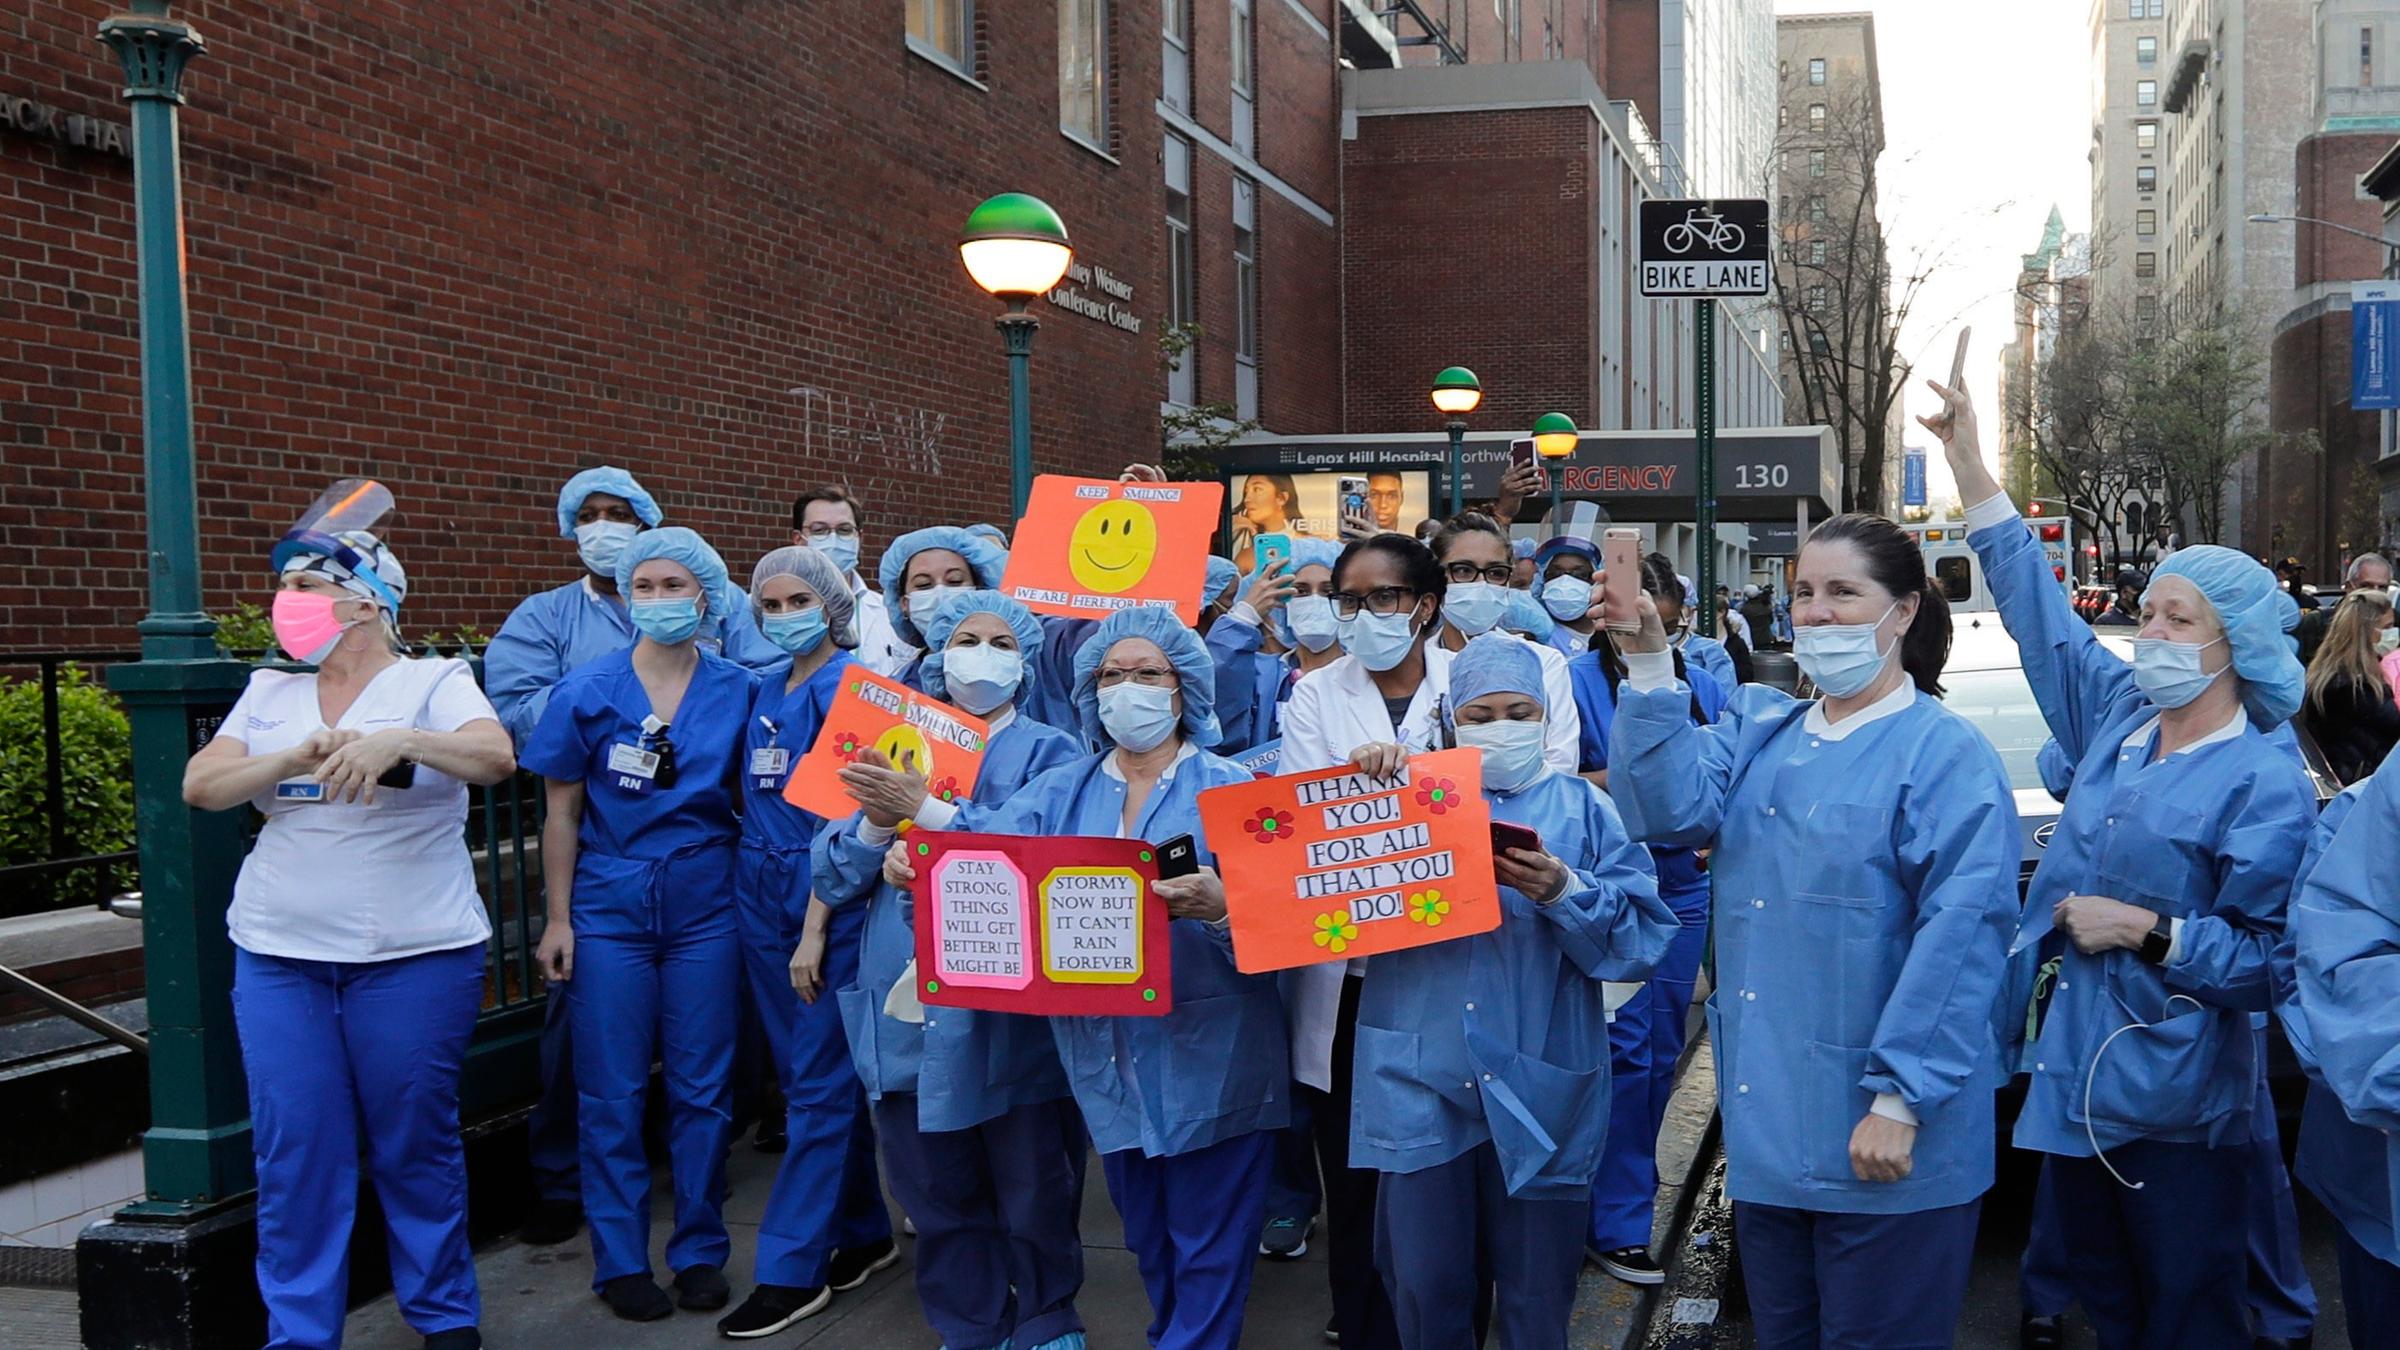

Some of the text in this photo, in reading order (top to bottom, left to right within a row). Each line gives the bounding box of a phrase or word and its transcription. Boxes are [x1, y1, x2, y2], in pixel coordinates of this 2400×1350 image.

[1094, 265, 1133, 302] Weisner
[1646, 265, 1762, 289] BIKE LANE
[1048, 287, 1141, 334] Conference Center
[1297, 451, 1344, 465] Lenox
[1349, 450, 1375, 464] Hill
[1379, 450, 1444, 463] Hospital
[1537, 465, 1677, 491] RGENCY
[1735, 464, 1789, 489] 130
[1077, 486, 1108, 498] KEEP
[1016, 588, 1038, 599] WE
[1040, 591, 1067, 603] ARE
[1073, 596, 1107, 607] HERE
[1110, 598, 1135, 609] FOR
[861, 683, 980, 752] KEEP SMILING!!
[618, 776, 642, 790] RN
[759, 778, 775, 788] RN
[1296, 771, 1408, 804] THANK
[290, 787, 308, 796] RN
[1326, 797, 1399, 829] YOU,
[1310, 825, 1429, 866] FOR ALL
[957, 861, 997, 875] STAY
[1055, 876, 1129, 890] STORMY
[1296, 853, 1451, 899] THAT YOU
[951, 901, 1009, 915] THINGS
[1051, 896, 1136, 910] NOW BUT
[1352, 893, 1403, 923] DO!
[945, 920, 1016, 935] WILL GET
[1056, 916, 1133, 930] IT CAN'T
[943, 940, 1021, 955] BETTER! IT
[1073, 936, 1117, 949] RAIN
[946, 960, 1021, 975] MIGHT BE
[1058, 956, 1135, 970] FOREVER
